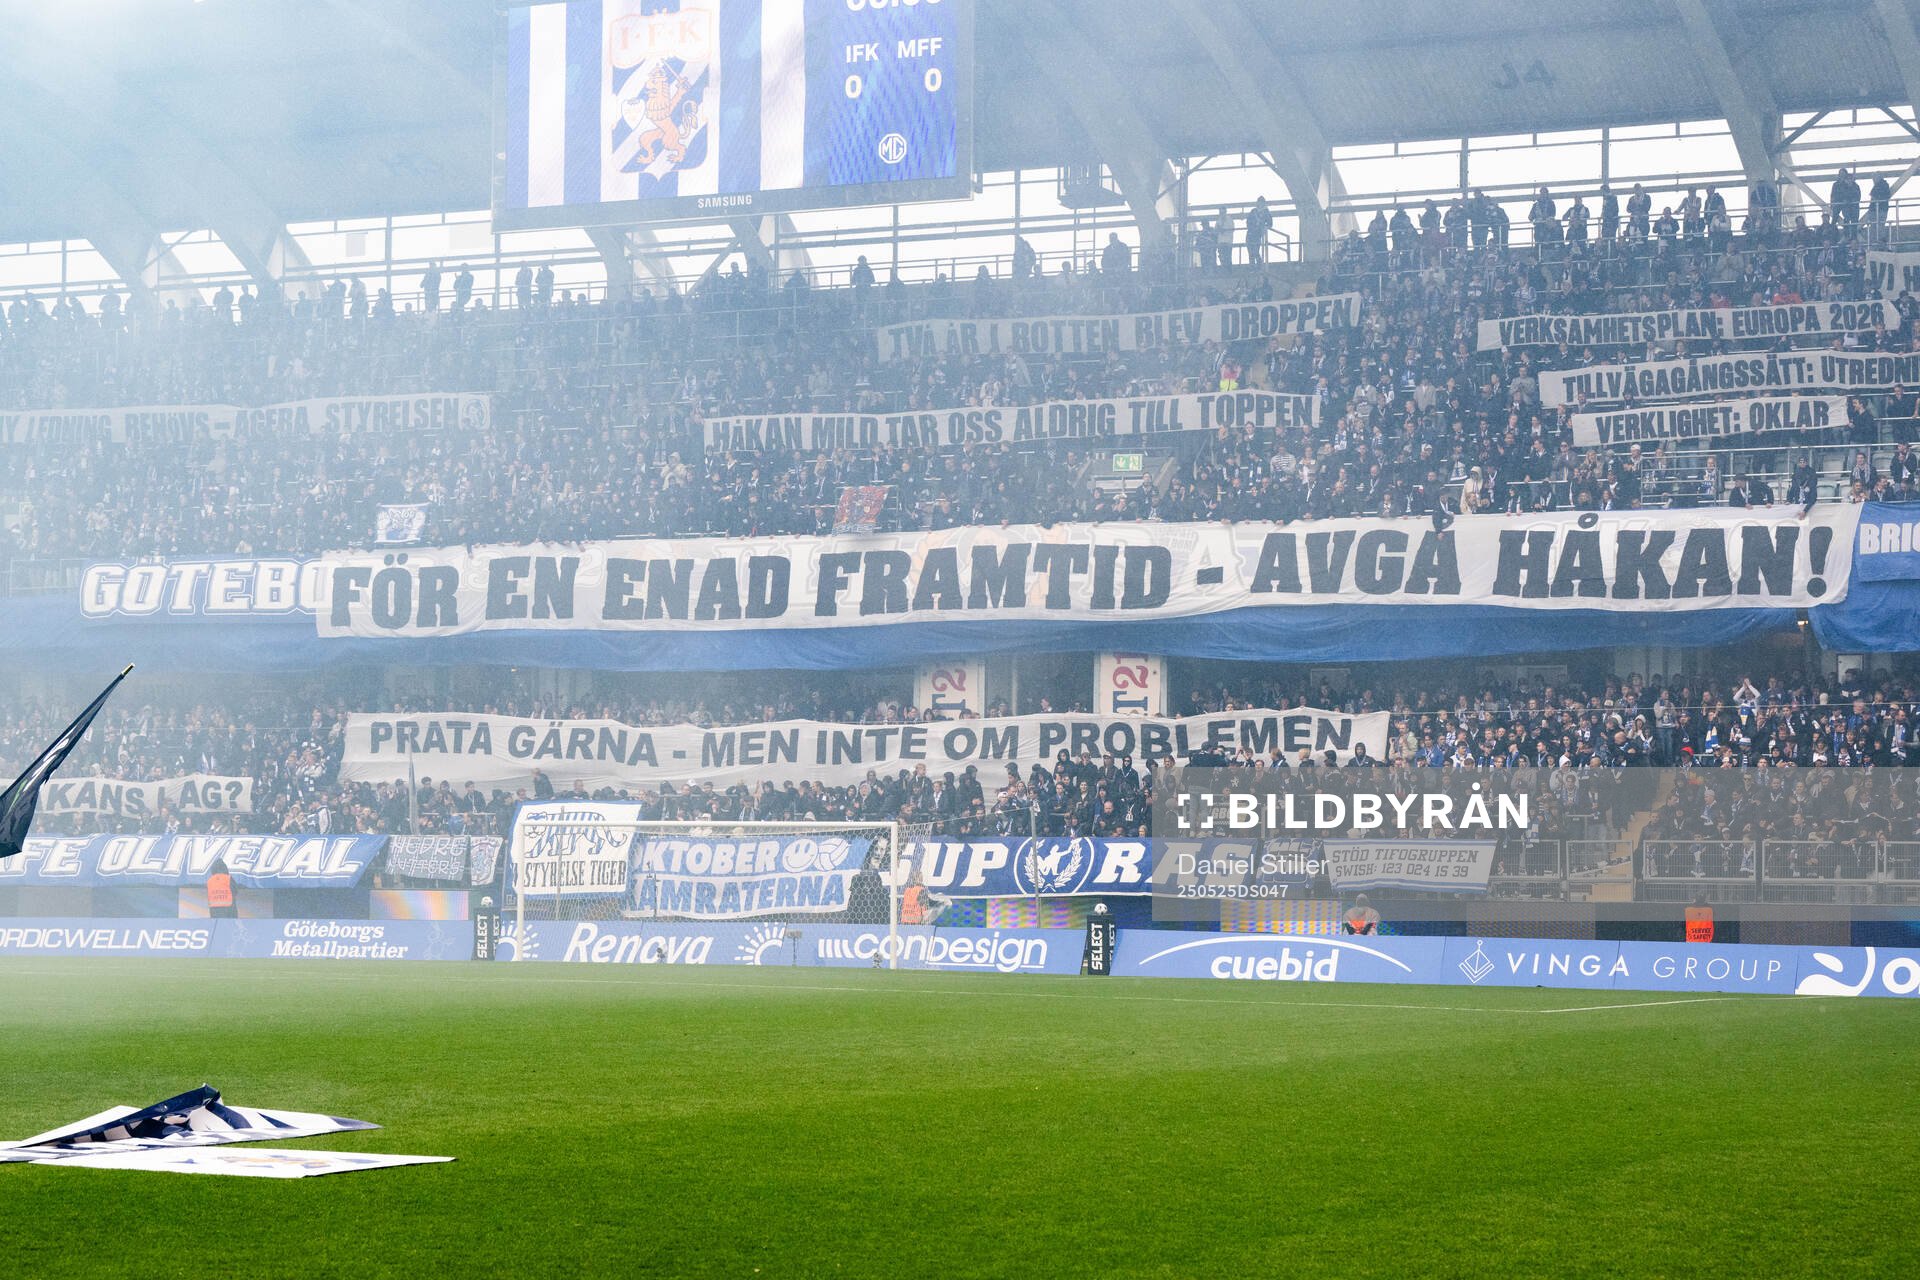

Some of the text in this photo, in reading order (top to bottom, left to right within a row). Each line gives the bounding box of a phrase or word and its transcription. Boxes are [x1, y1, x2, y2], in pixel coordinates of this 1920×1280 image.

[845, 36, 943, 63] IFK MFF
[845, 67, 943, 99] 0 0
[879, 134, 906, 163] MG
[697, 194, 753, 209] SAMSUNG
[888, 323, 937, 351] TVÅ
[947, 322, 978, 351] ÅR
[1011, 319, 1119, 351] BOTTEN
[1135, 311, 1204, 348] BLEV
[1220, 298, 1353, 340] DROPPEN
[1500, 302, 1885, 346] VERKSAMHETSPLAN: EUROPA 2026
[1562, 355, 1814, 404] TILLVÄGAGÅNGSSÄTT:
[325, 398, 459, 434] STYRELSEN
[712, 393, 1314, 451] HÅKAN MILD TAR OSS ALDRIG TILL TOPPEN
[1595, 400, 1830, 443] VERKLIGHET: OKLAR
[331, 553, 460, 629] FÖR
[485, 555, 580, 620] EN
[602, 555, 791, 620] ENAD
[815, 543, 1172, 616] FRAMTID
[1197, 566, 1223, 585] -
[1493, 512, 1834, 599] HÅKAN!
[370, 715, 1353, 768] PRATA GÄRNA - MEN INTE OM PROBLEMEN
[157, 780, 244, 810] LAG?
[98, 836, 363, 877] OLIVEDAL
[879, 842, 1009, 888] SUP
[1092, 841, 1253, 887] RAS
[1332, 846, 1369, 864] STÖD
[1375, 848, 1479, 864] TIFOGRUPPEN
[1336, 864, 1378, 878] SWISH:
[1381, 862, 1402, 875] 123
[1434, 865, 1448, 878] 15
[1452, 865, 1469, 878] 39
[523, 860, 585, 888] STYRELSE
[590, 860, 627, 886] TIGER
[283, 919, 385, 940] Göteborgs
[477, 914, 488, 959] SELECT
[563, 922, 714, 964] Renova
[1091, 923, 1103, 971] SELECT
[272, 940, 409, 961] Metallpartier
[1210, 947, 1340, 982] cuebid
[1506, 951, 1784, 983] VINGA GROUP
